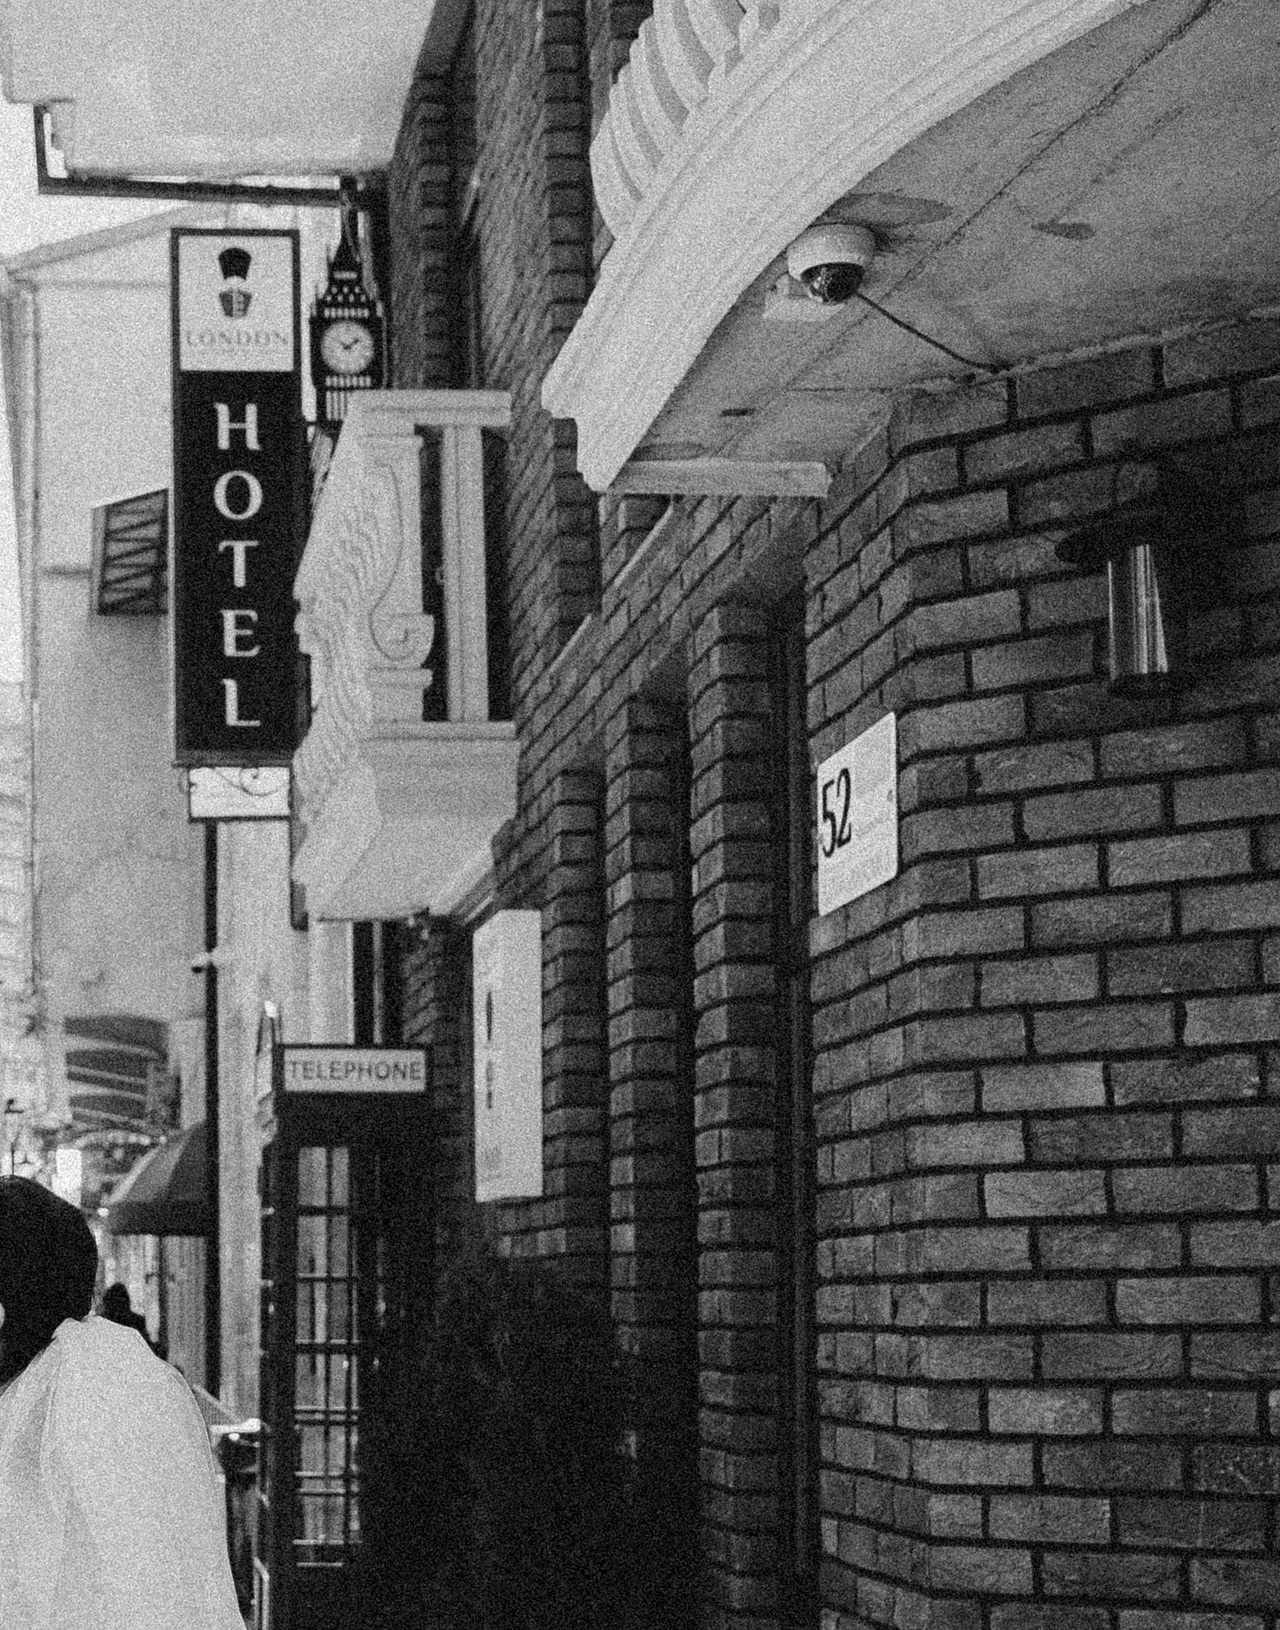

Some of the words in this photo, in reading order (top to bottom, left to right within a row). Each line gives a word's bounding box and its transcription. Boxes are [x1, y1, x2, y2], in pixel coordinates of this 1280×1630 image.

[184, 329, 289, 347] LONDON
[214, 403, 263, 727] HOTEL
[822, 767, 852, 858] 52
[286, 1060, 422, 1082] TELEPHONE
